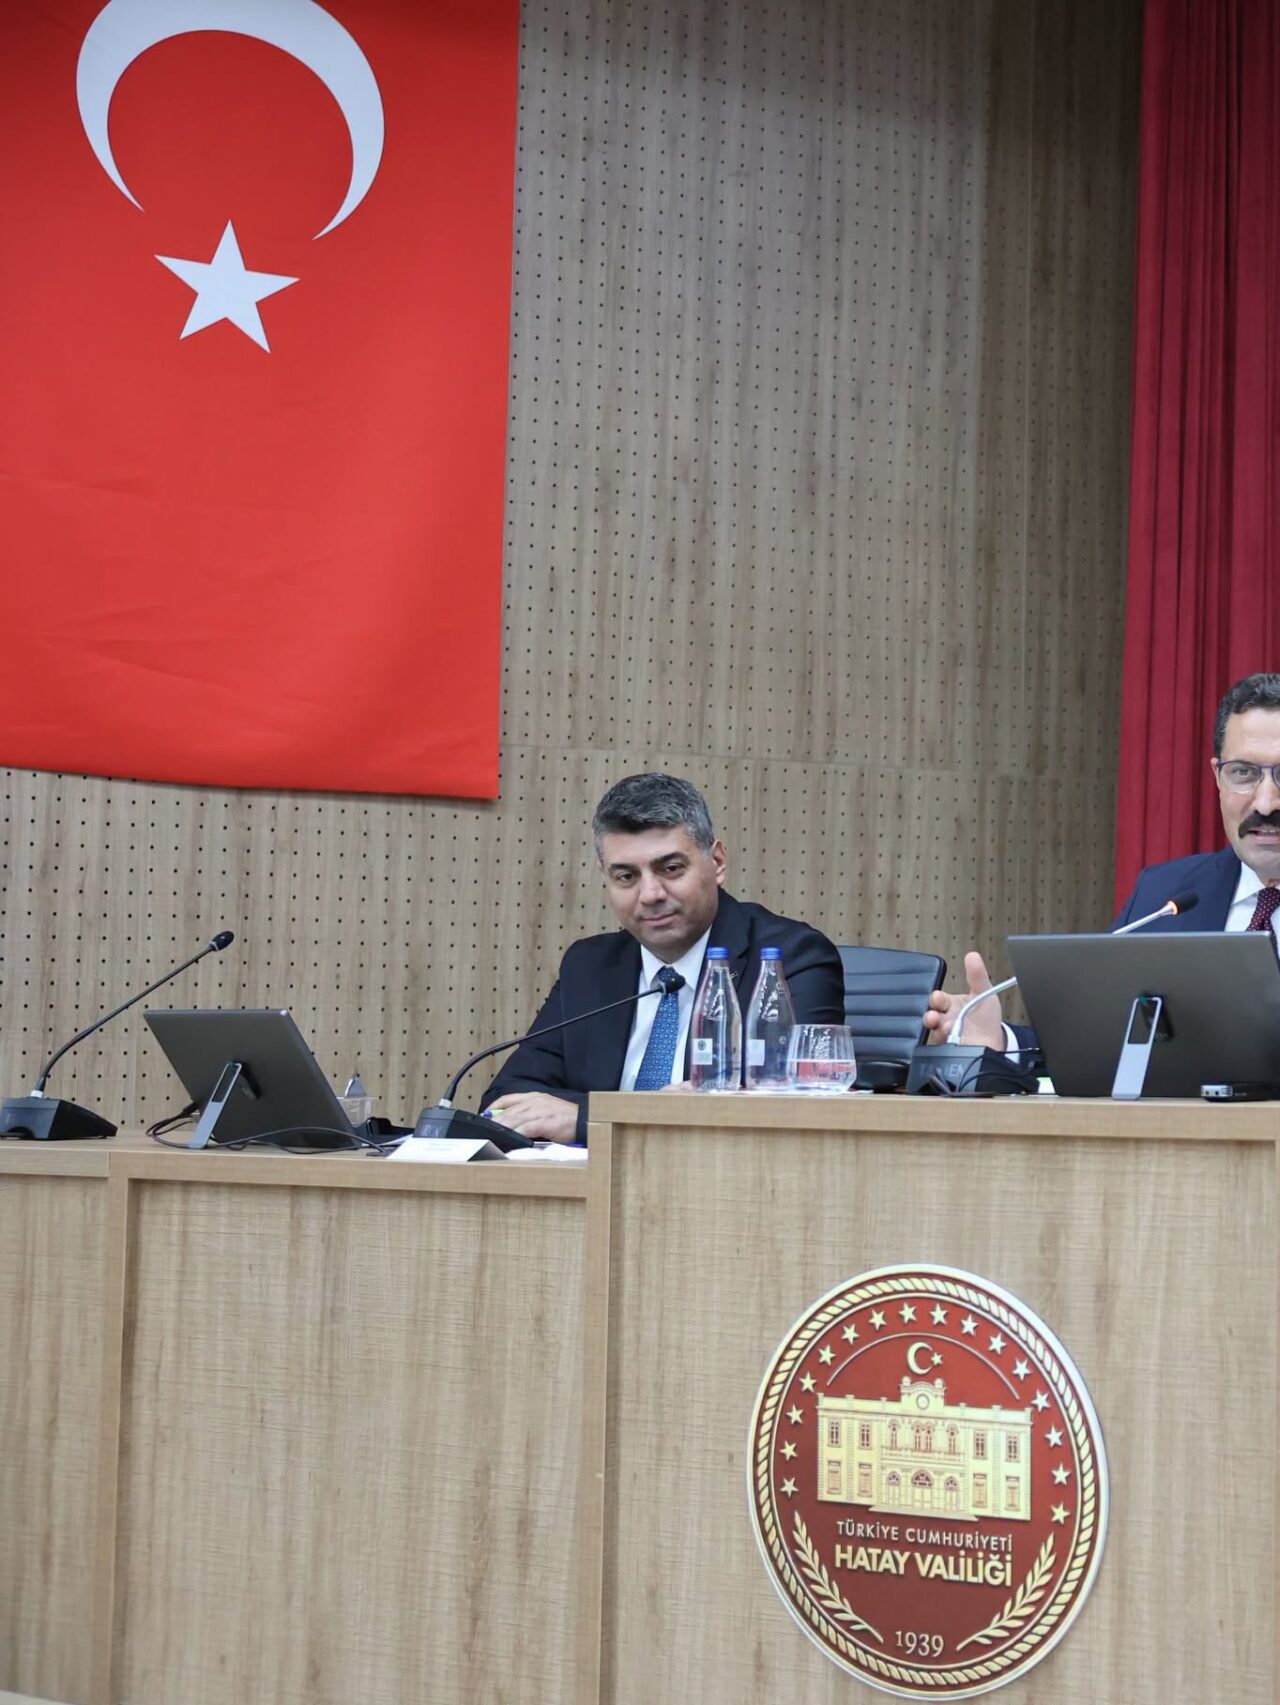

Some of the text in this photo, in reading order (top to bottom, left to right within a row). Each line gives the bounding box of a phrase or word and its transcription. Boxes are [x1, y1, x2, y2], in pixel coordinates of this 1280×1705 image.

[836, 1519, 1013, 1552] TÜRKİYE CUMHURİYETİ
[834, 1544, 1013, 1587] HATAY VALİLİĞİ
[895, 1630, 945, 1658] 1939
